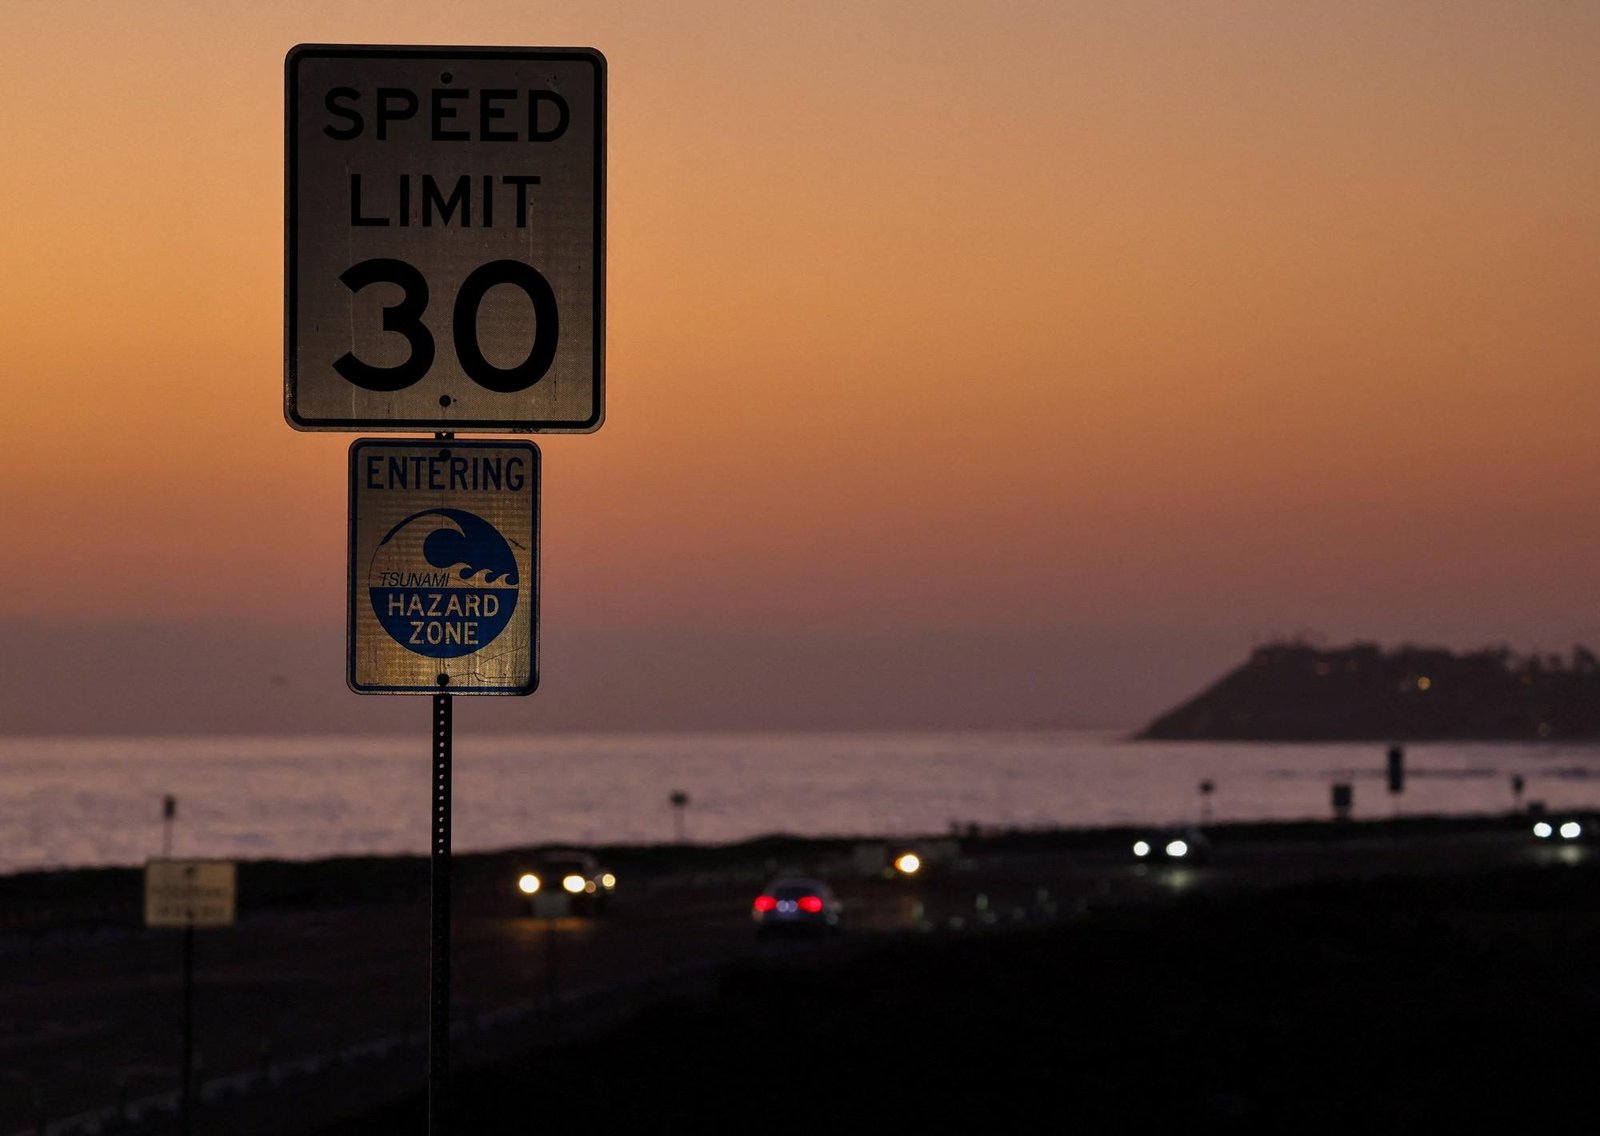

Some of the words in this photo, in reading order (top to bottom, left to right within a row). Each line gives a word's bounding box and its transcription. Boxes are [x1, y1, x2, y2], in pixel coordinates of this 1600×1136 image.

[322, 86, 571, 142] SPEED
[350, 173, 541, 228] LIMIT
[331, 257, 560, 393] 30
[367, 455, 524, 491] ENTERING
[380, 571, 450, 587] TSUNAMI
[387, 592, 500, 617] HAZARD
[408, 620, 479, 645] ZONE
